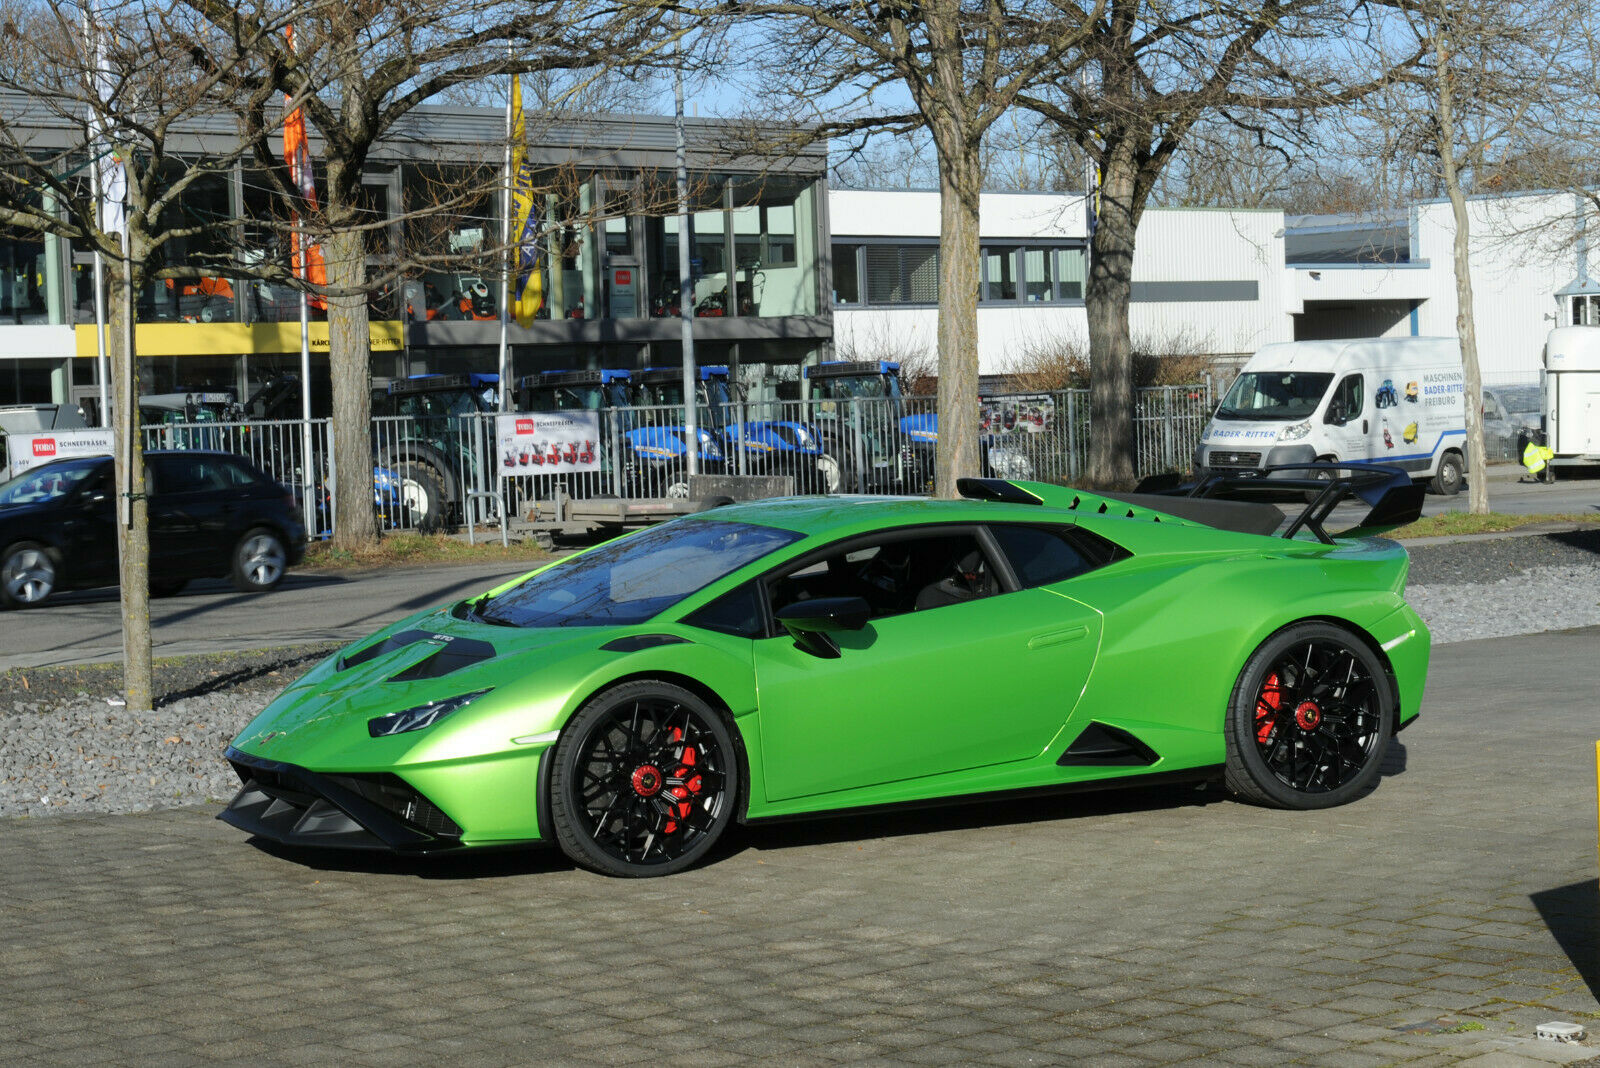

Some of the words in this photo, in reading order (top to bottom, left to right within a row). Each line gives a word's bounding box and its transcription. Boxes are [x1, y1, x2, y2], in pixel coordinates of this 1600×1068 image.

[1423, 372, 1463, 382] MASCHINEN
[1425, 396, 1456, 407] FREIBURG
[1213, 429, 1276, 438] BADER-RITTER
[33, 443, 55, 452] TORO
[59, 440, 107, 448] SCHNEEFRÄSEN
